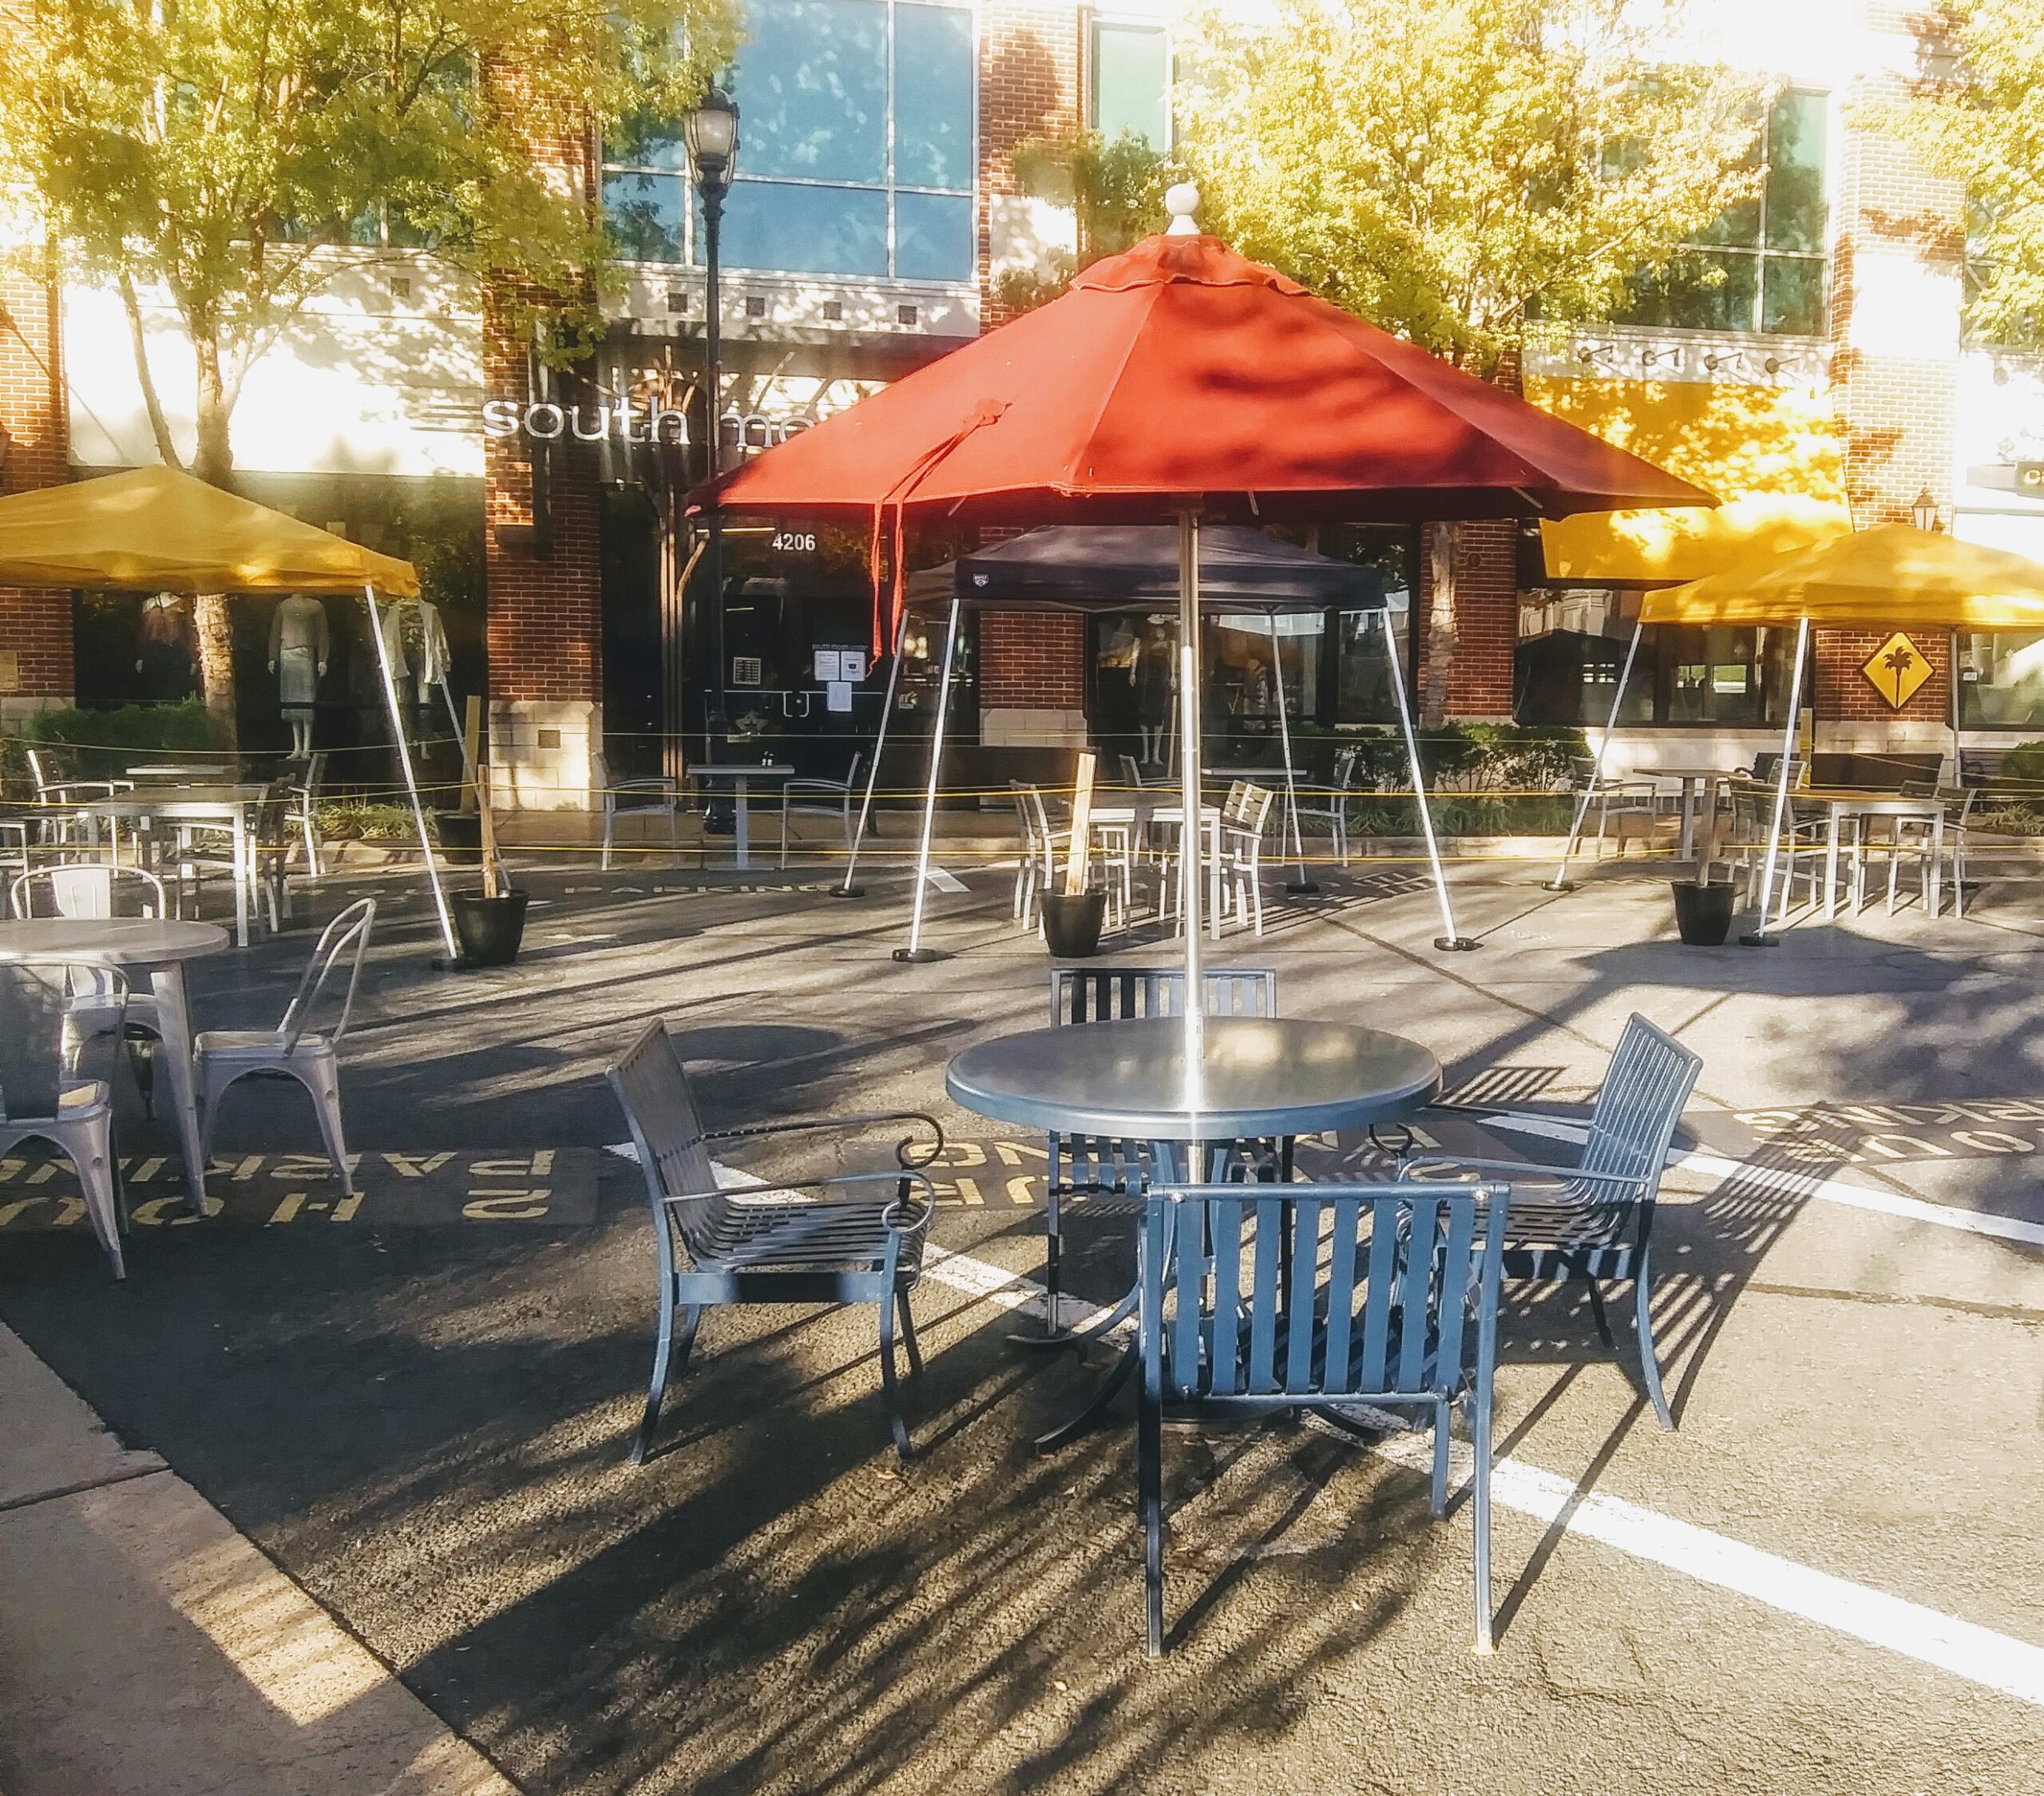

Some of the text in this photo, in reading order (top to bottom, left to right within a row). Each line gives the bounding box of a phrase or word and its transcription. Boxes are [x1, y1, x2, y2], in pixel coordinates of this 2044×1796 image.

[482, 396, 690, 445] south
[771, 532, 816, 551] 4206
[564, 884, 835, 894] PARKING
[1733, 1100, 2044, 1133] RKING
[1752, 1127, 2044, 1163] OUR
[461, 1189, 552, 1220] 2
